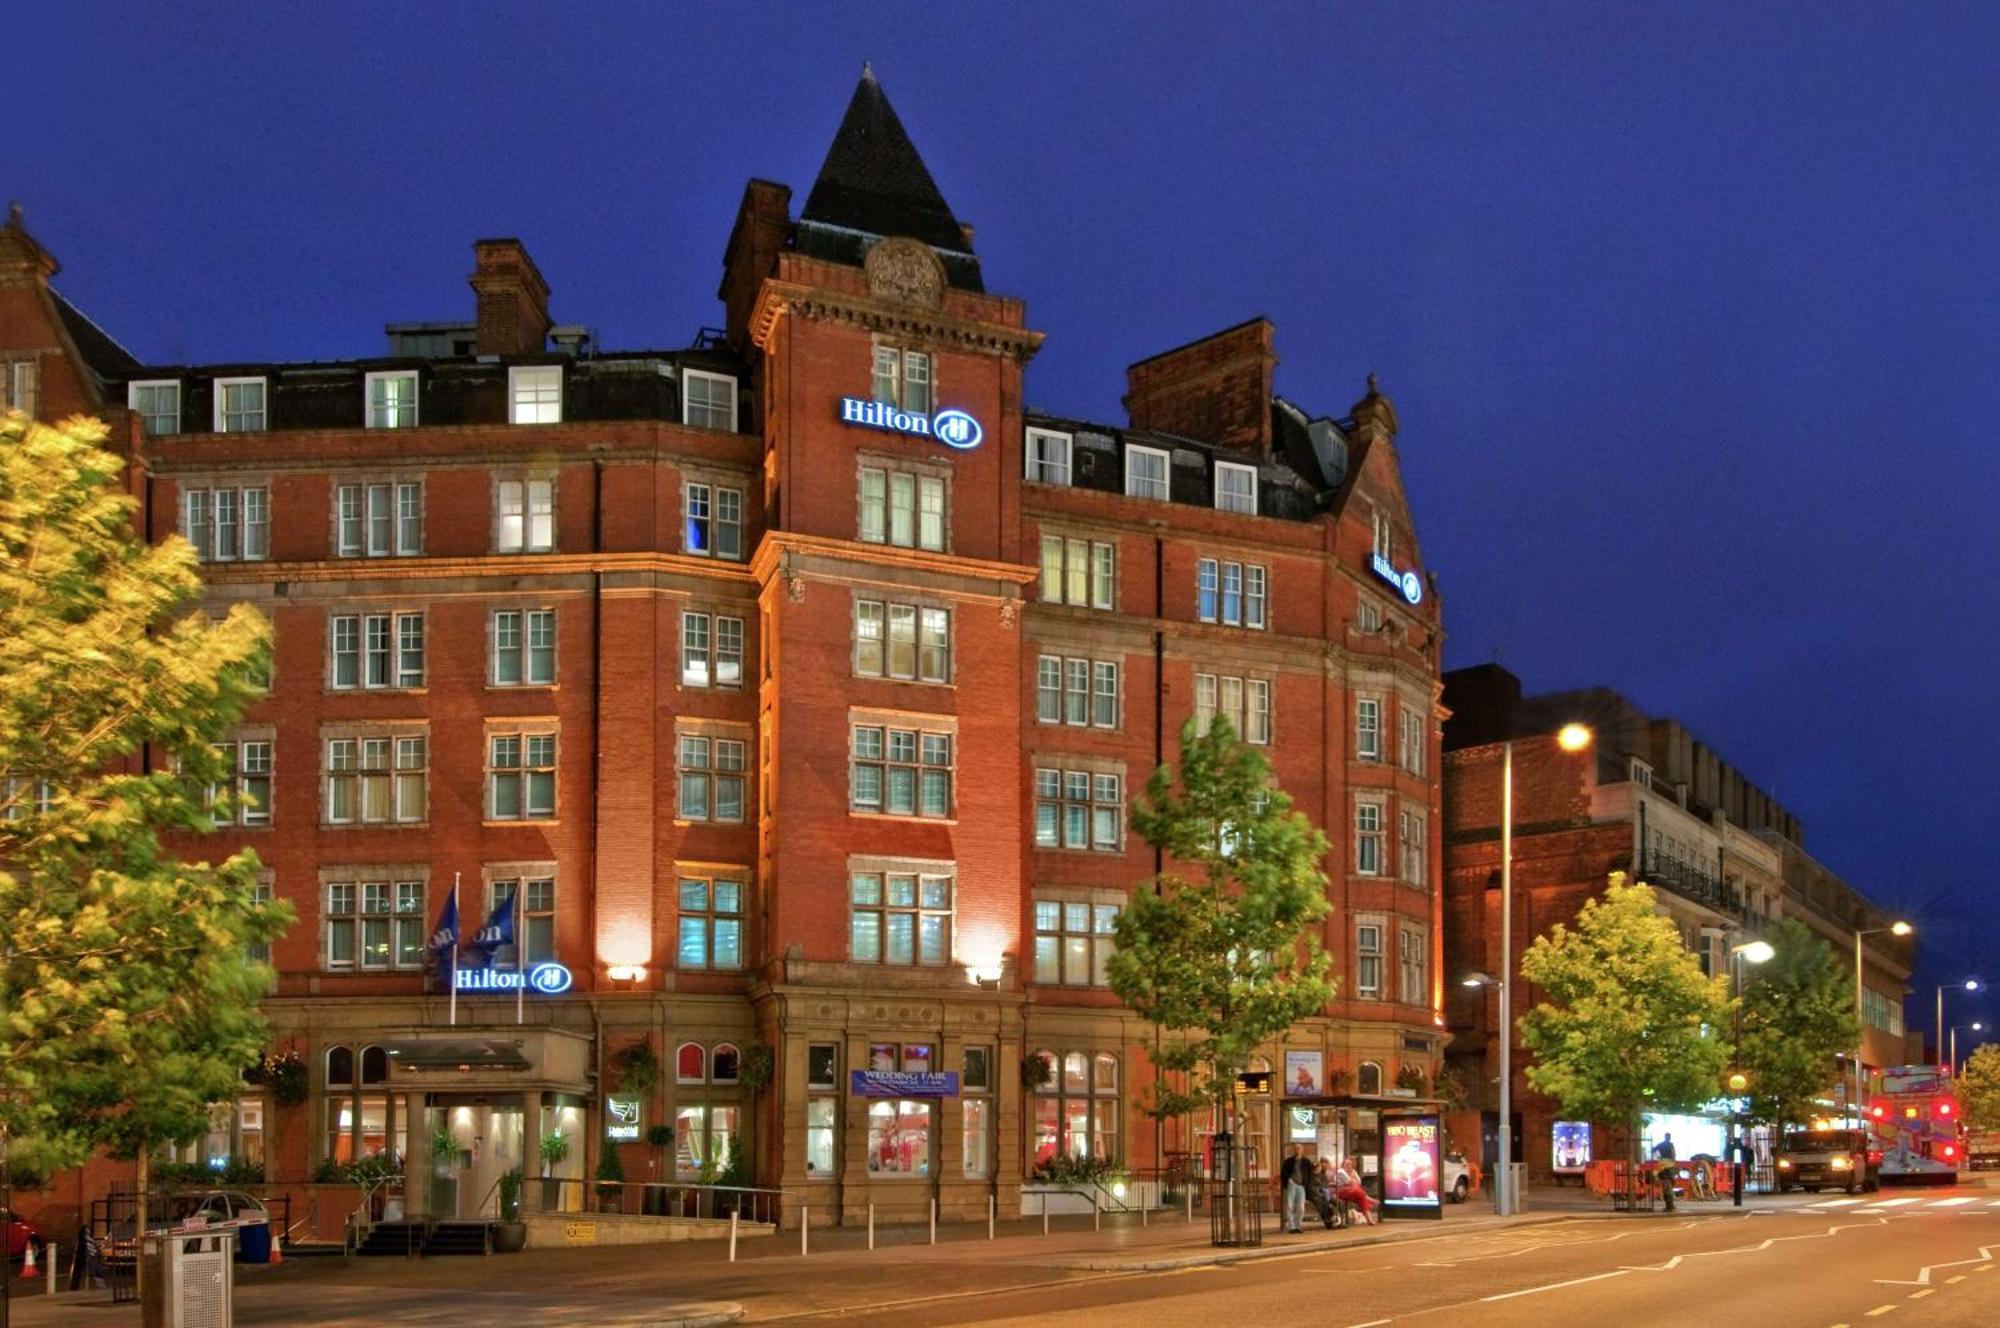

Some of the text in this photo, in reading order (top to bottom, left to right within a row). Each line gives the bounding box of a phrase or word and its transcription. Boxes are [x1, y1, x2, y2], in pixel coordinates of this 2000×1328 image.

[843, 398, 930, 434] Hilton
[456, 967, 526, 989] Hilton
[864, 1070, 918, 1080] WEDDING
